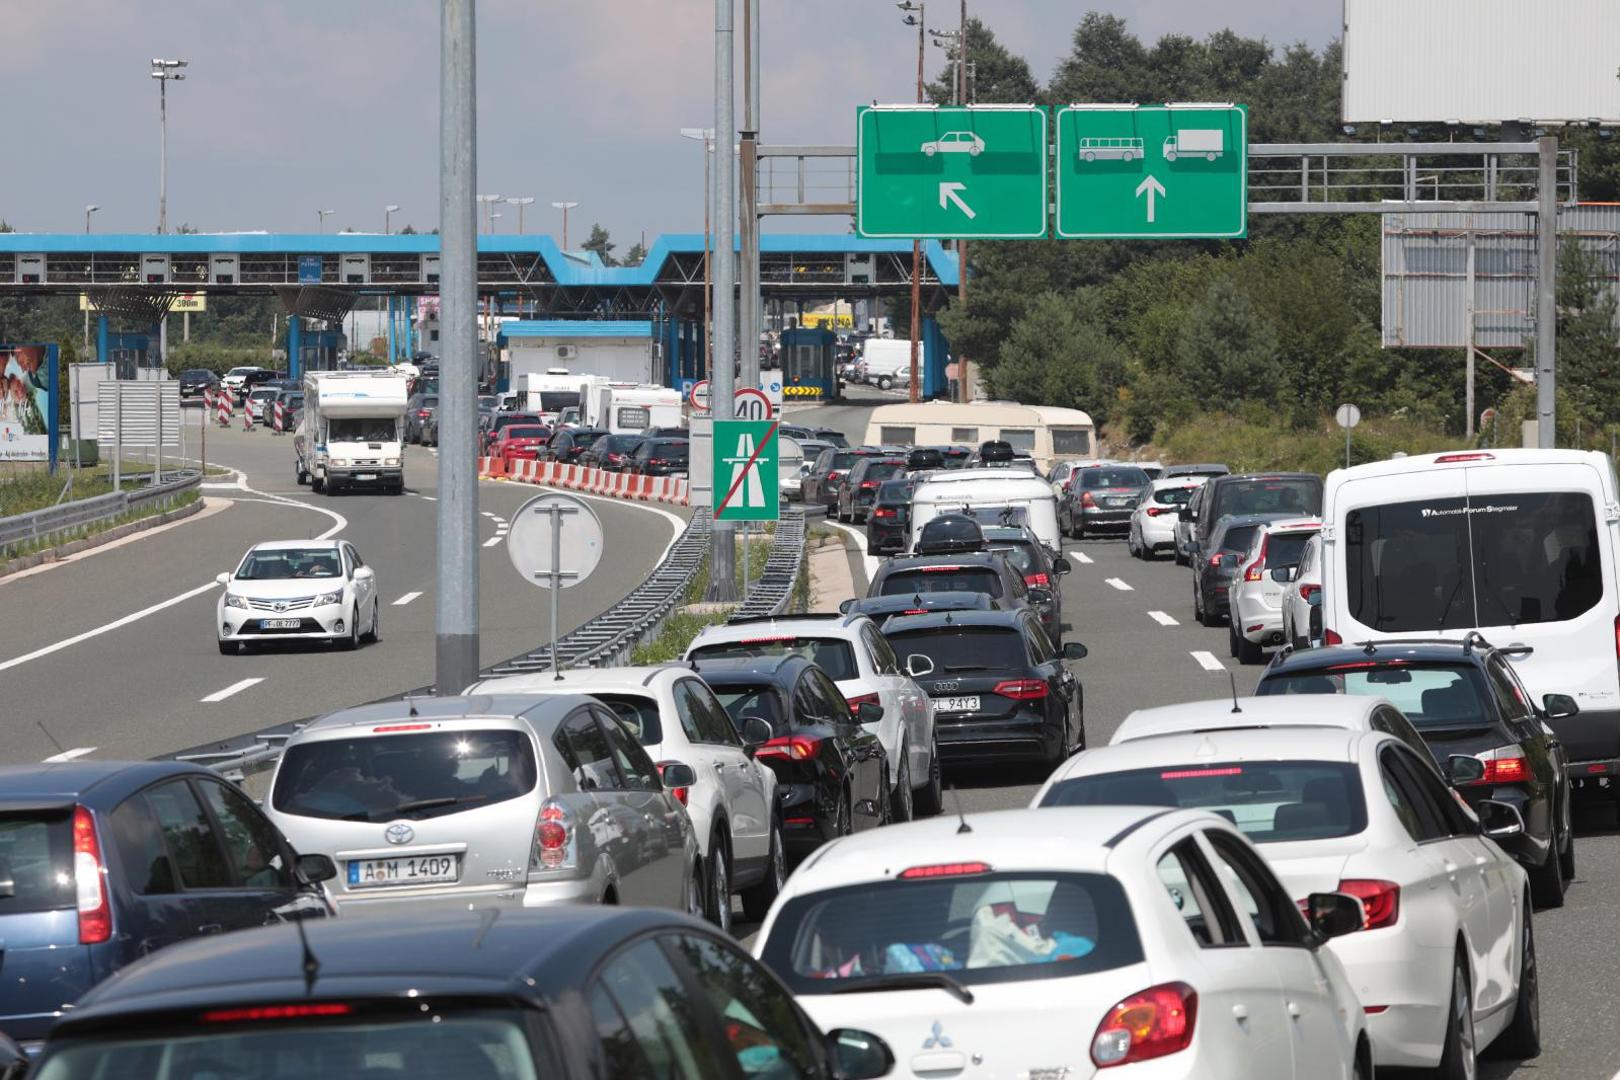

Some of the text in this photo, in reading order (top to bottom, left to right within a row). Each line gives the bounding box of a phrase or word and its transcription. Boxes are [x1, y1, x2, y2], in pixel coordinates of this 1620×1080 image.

[736, 400, 762, 420] 40
[949, 697, 978, 709] 94Y3
[365, 858, 450, 880] A M 1409
